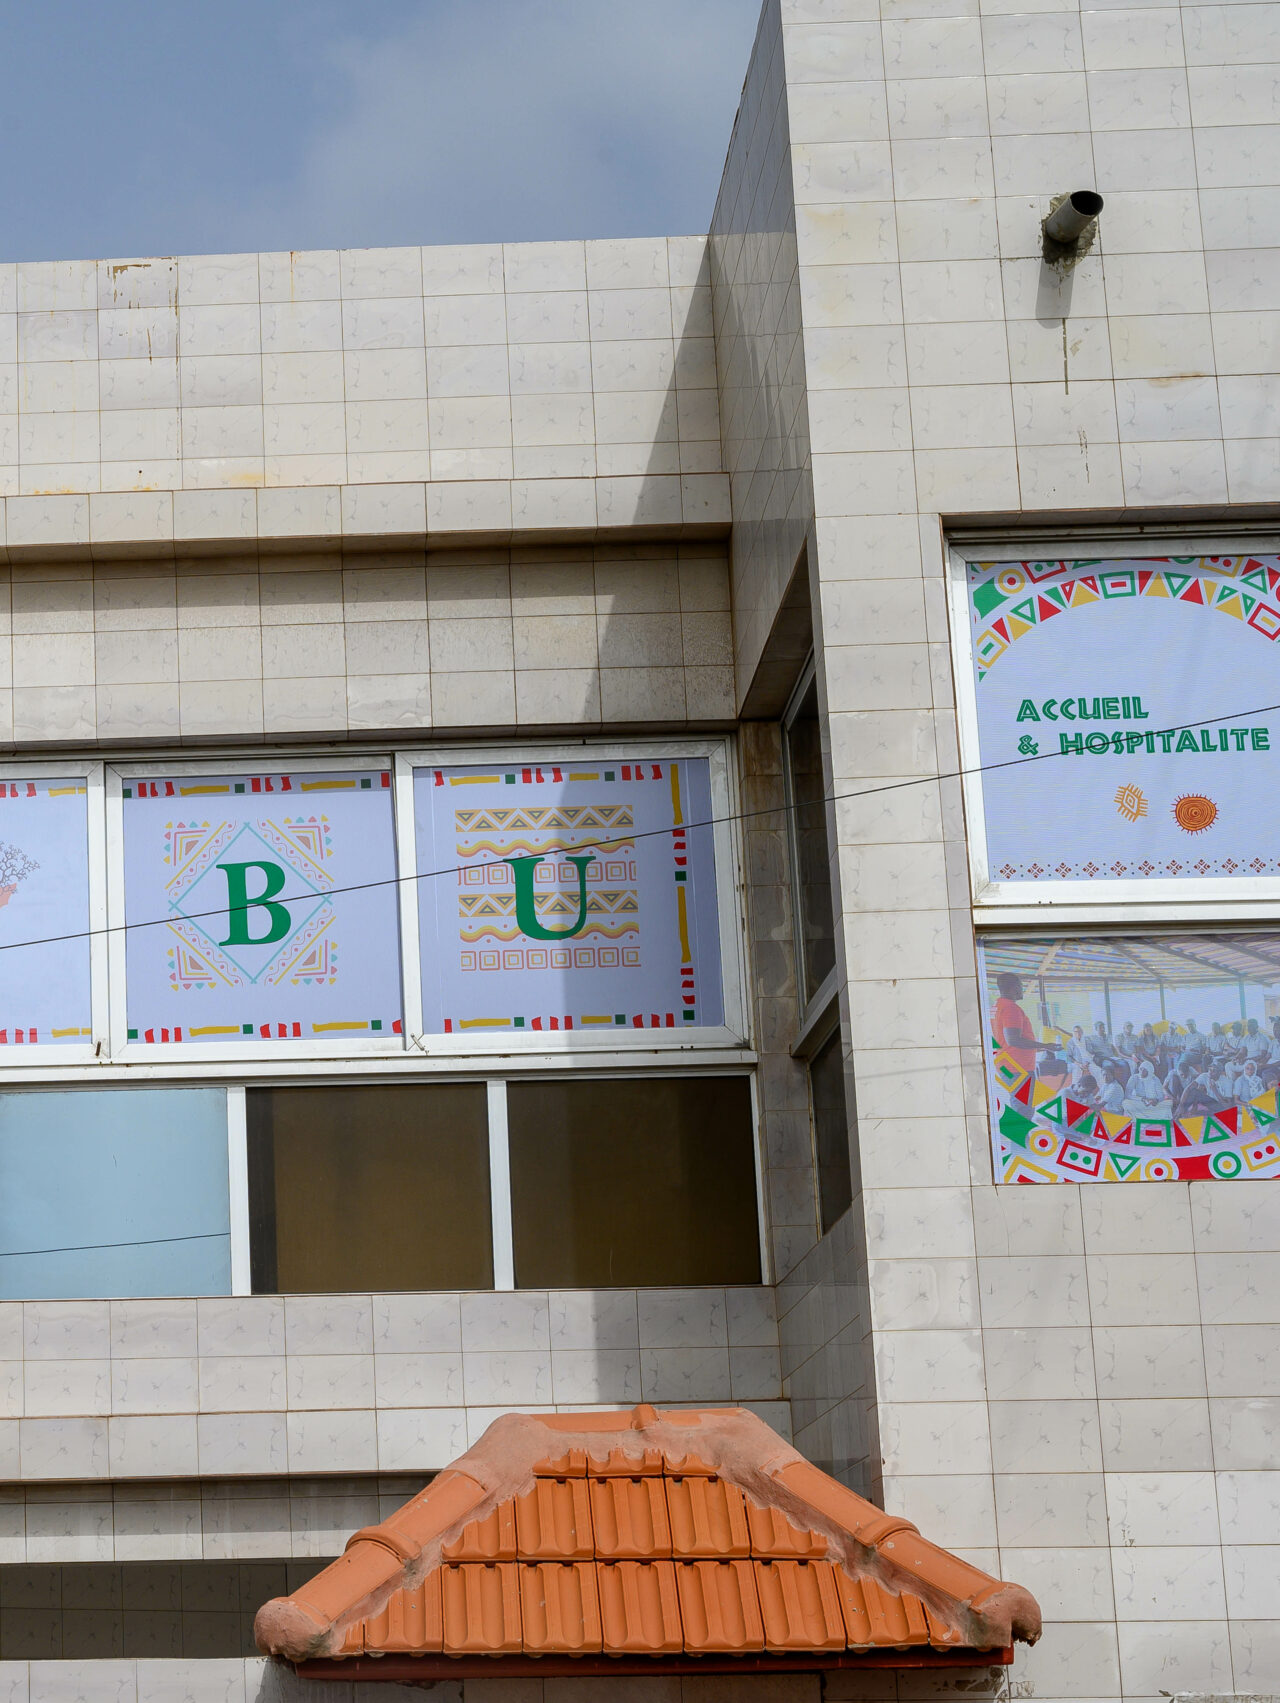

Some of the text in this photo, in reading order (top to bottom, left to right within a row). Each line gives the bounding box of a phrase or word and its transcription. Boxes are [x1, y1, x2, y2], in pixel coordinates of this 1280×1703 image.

[1016, 696, 1149, 722] ACCUEIL
[1017, 727, 1270, 756] & HOSPITALITE
